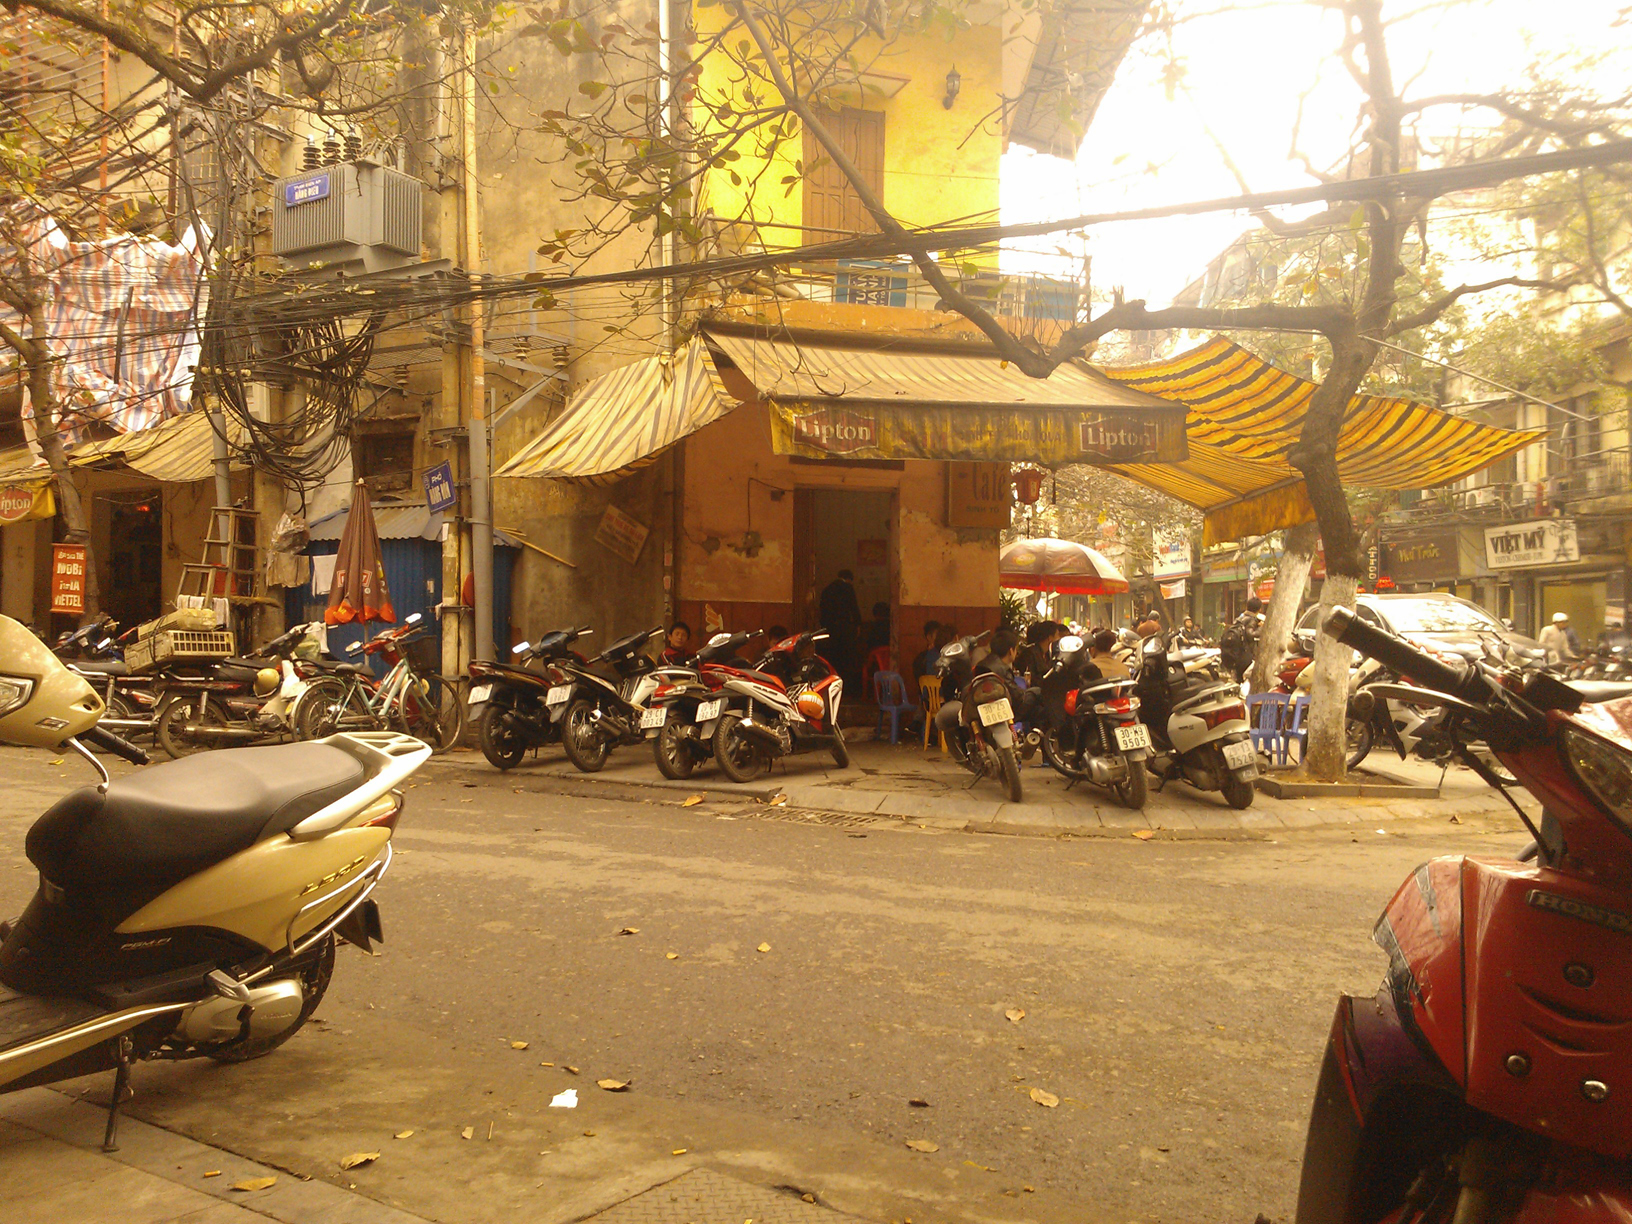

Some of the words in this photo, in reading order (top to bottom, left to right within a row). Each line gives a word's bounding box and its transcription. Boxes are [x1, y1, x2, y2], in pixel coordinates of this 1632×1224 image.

[800, 418, 872, 443] Lipton
[1087, 426, 1152, 450] Lipton
[0, 496, 31, 514] ipton
[1490, 531, 1521, 554] VIỆT
[1523, 526, 1546, 550] MỸ
[985, 710, 1009, 723] 8065
[1122, 737, 1147, 749] 9505
[1230, 752, 1255, 768] 7526
